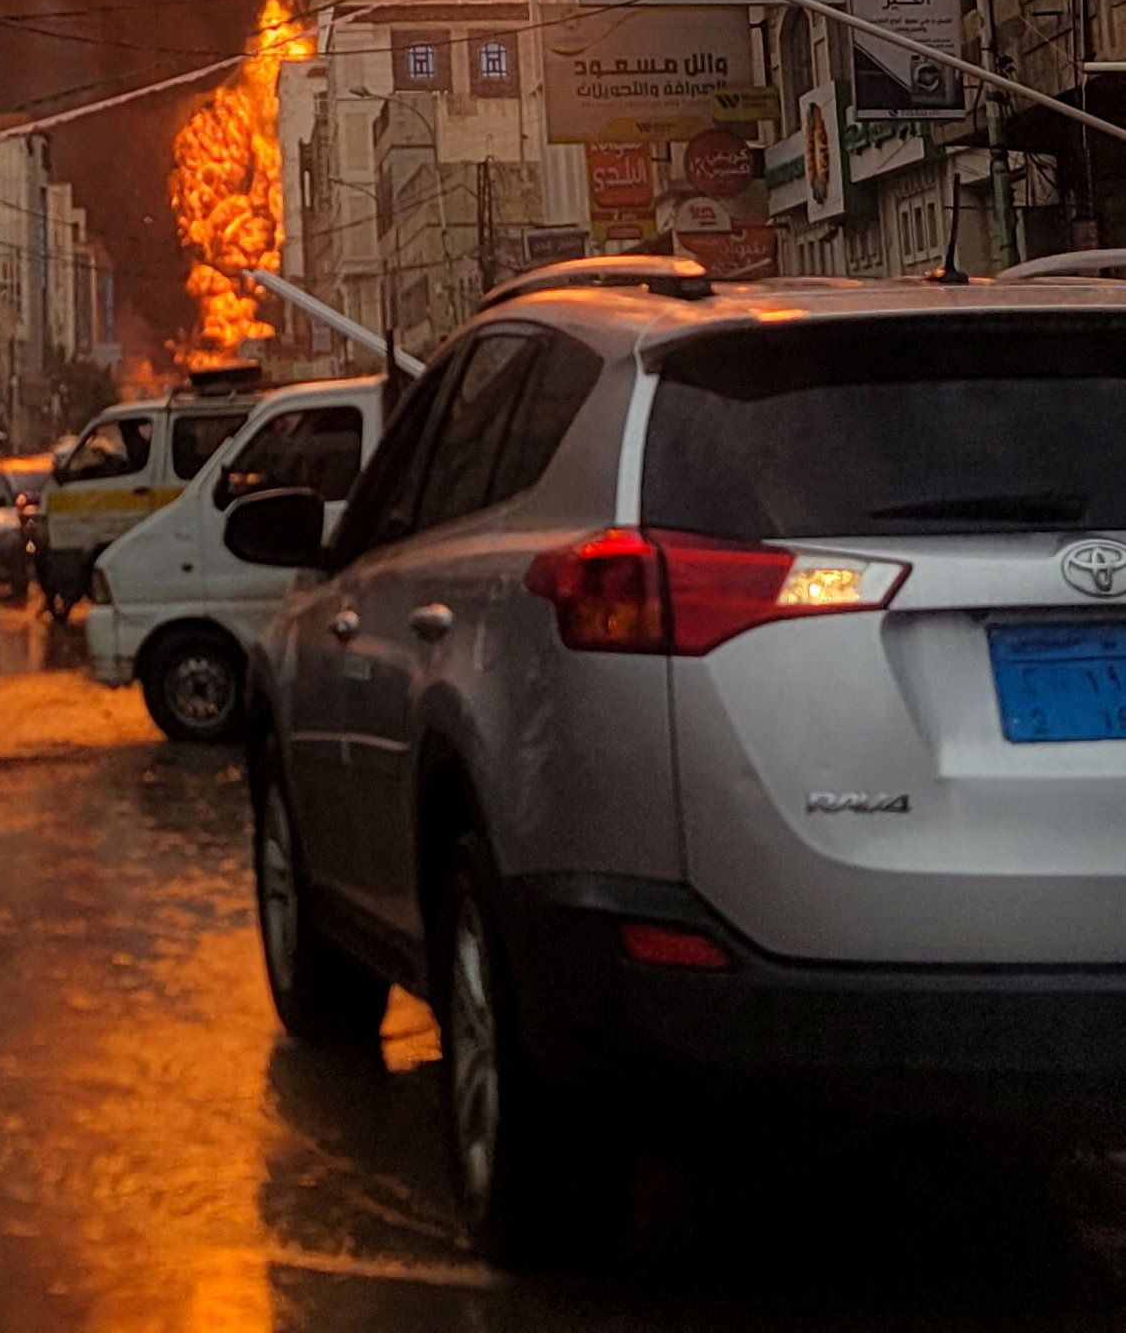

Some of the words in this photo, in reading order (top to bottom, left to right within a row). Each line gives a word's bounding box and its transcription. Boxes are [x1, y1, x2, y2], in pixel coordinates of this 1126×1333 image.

[574, 55, 678, 79] مسعود
[685, 52, 728, 76] وائل
[577, 80, 659, 100] والتحويلات
